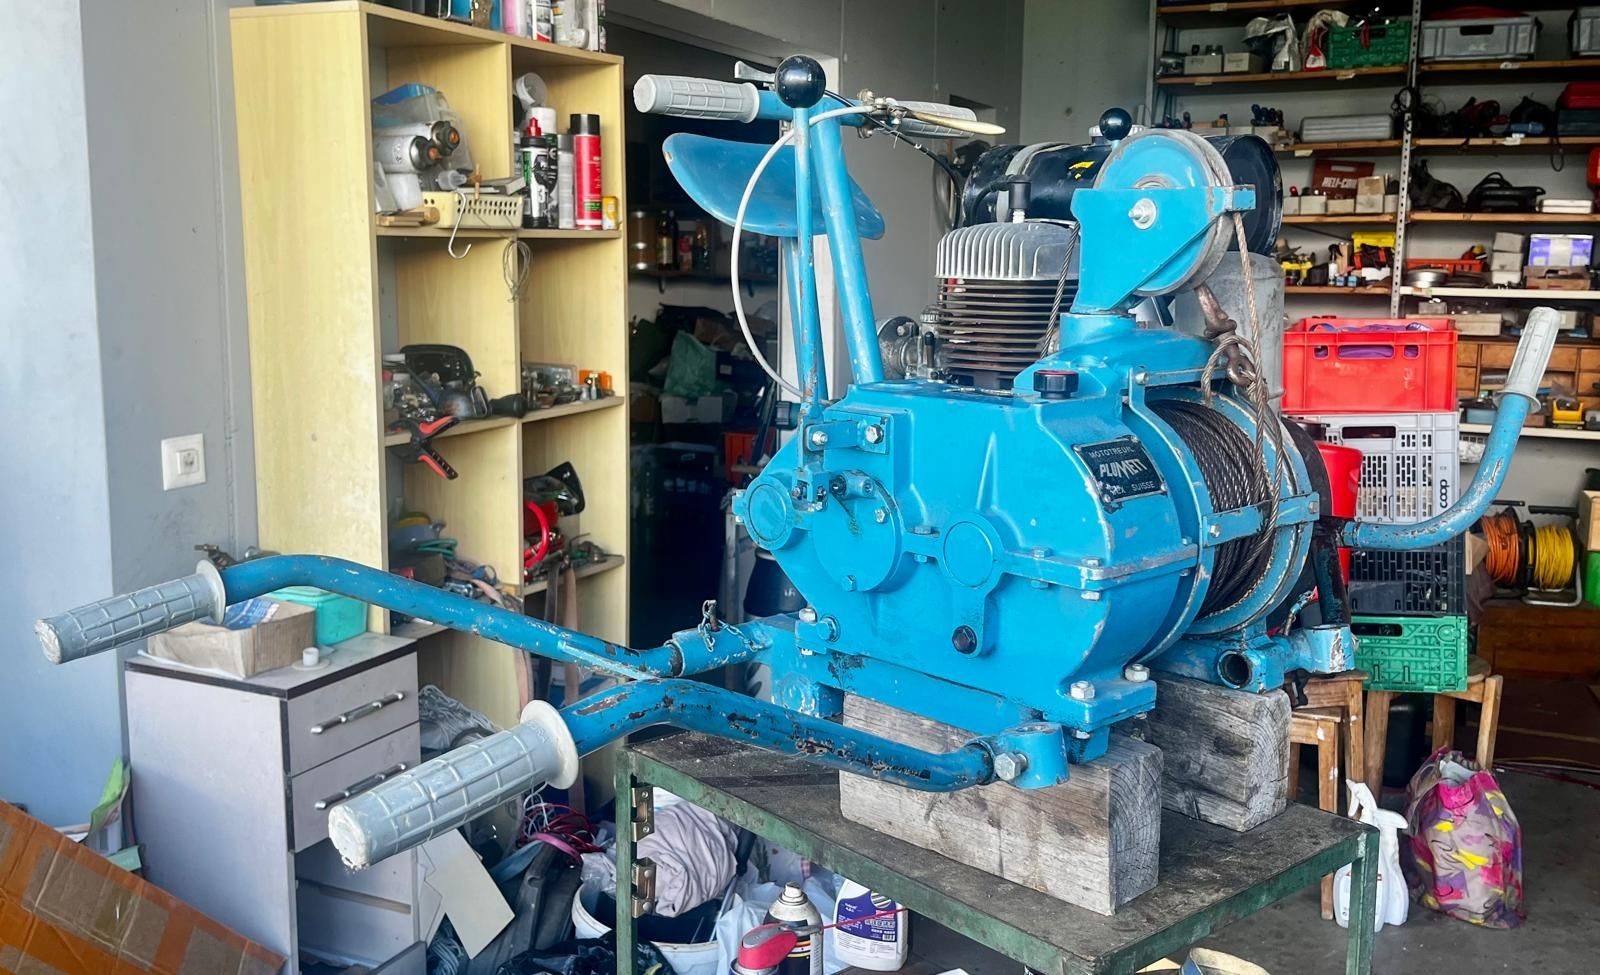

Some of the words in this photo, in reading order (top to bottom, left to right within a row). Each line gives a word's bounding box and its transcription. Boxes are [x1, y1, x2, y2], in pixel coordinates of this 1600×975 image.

[1088, 446, 1134, 458] MOTOTREUIL
[1100, 458, 1147, 479] PLUMETT
[1131, 481, 1155, 491] SUISSE
[1440, 479, 1450, 508] coop
